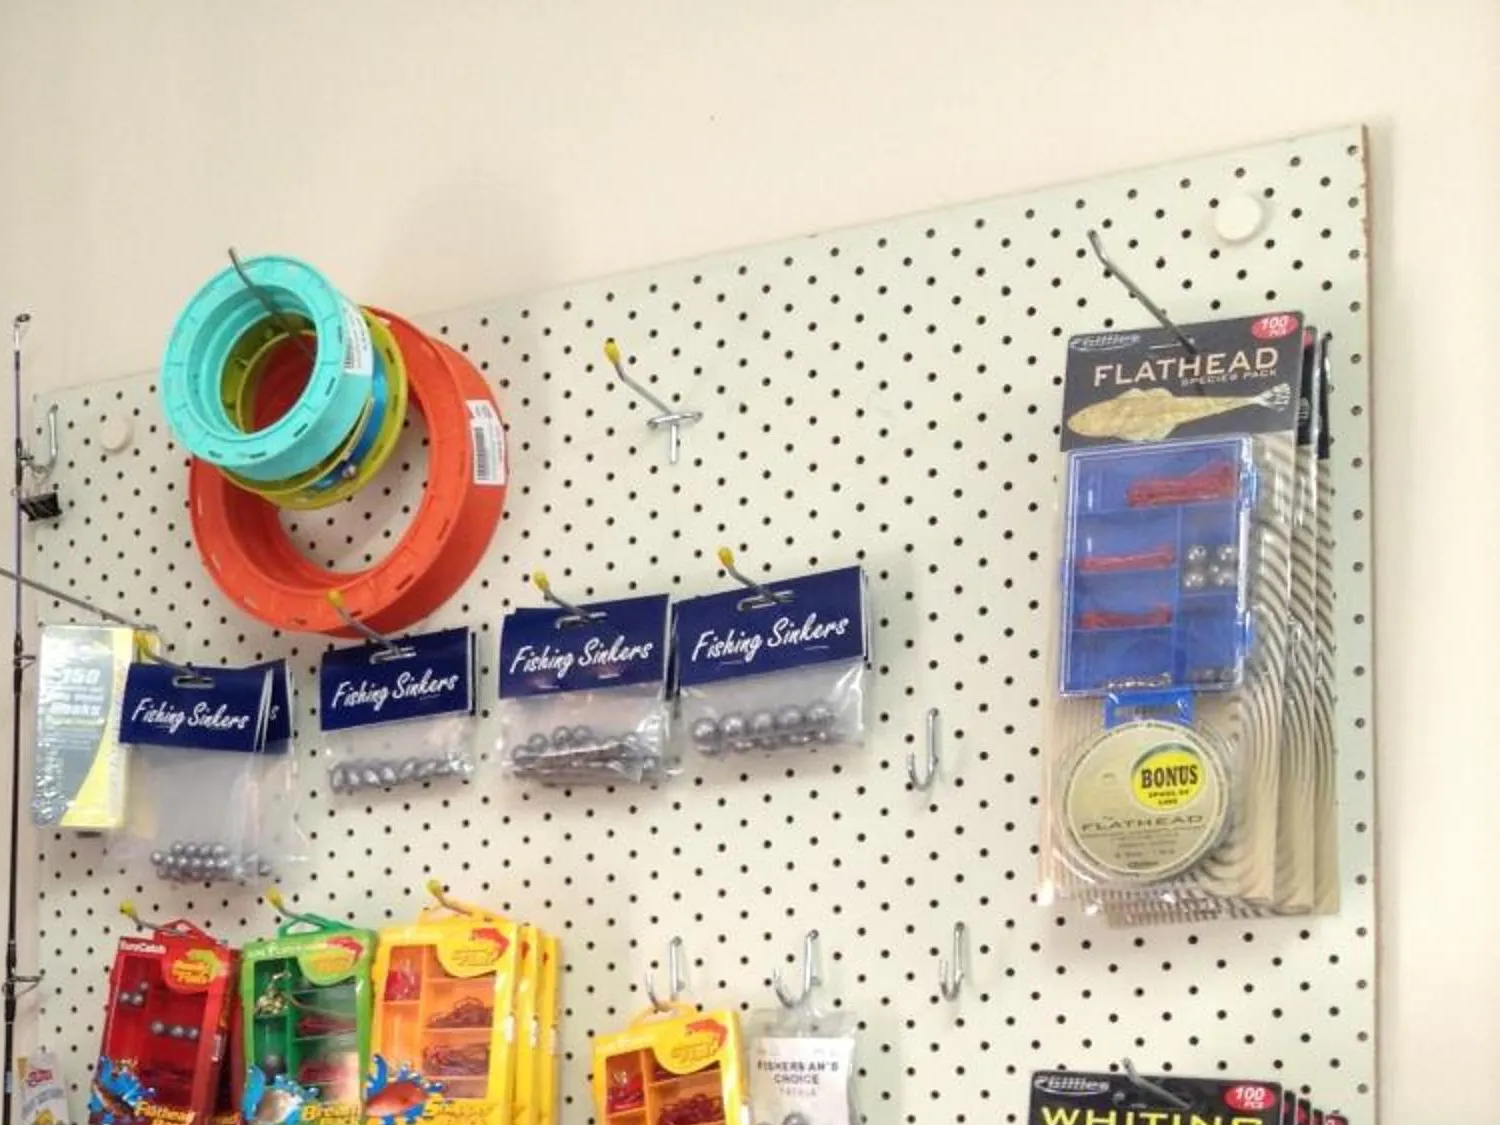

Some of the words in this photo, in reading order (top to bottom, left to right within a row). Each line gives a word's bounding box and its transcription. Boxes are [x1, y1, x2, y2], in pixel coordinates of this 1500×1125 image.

[1260, 316, 1287, 330] 100
[1094, 347, 1278, 387] FLATHEAD
[1243, 369, 1277, 379] PACK
[691, 627, 764, 663] Fishing
[767, 612, 849, 646] Sinkers
[509, 644, 574, 679] Fishing
[578, 634, 653, 667] Sinkers
[332, 681, 389, 710] Fishing
[393, 670, 460, 700] Sinkers
[132, 697, 184, 734] Fishing
[188, 701, 250, 729] Sinkers
[1141, 764, 1198, 789] BONUS
[773, 1074, 819, 1085] CHOICE
[1235, 1086, 1265, 1100] 100
